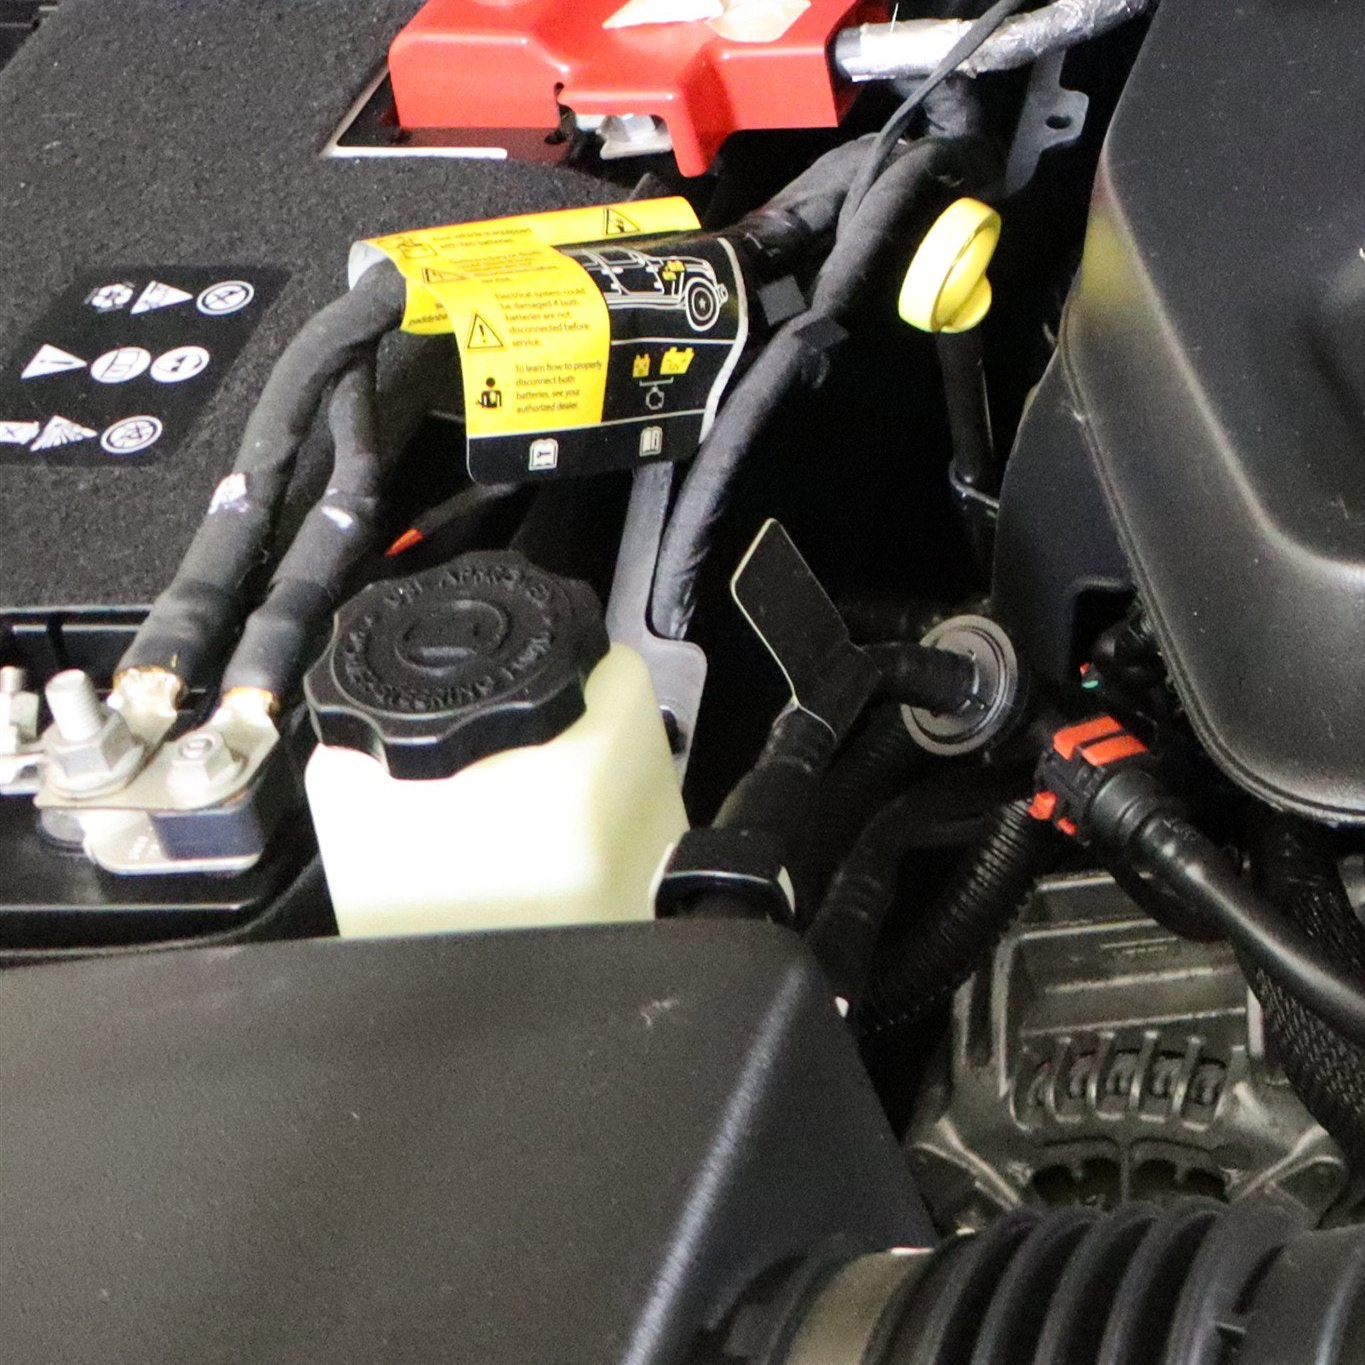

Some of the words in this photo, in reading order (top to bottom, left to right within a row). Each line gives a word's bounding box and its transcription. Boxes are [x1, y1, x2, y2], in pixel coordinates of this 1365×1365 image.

[525, 363, 544, 372] learn
[546, 362, 563, 371] how
[564, 362, 573, 370] to
[573, 360, 602, 371] properly
[516, 375, 557, 386] disconnect
[558, 374, 576, 383] both
[552, 389, 564, 397] see
[565, 388, 580, 399] your
[516, 402, 556, 413] authorized
